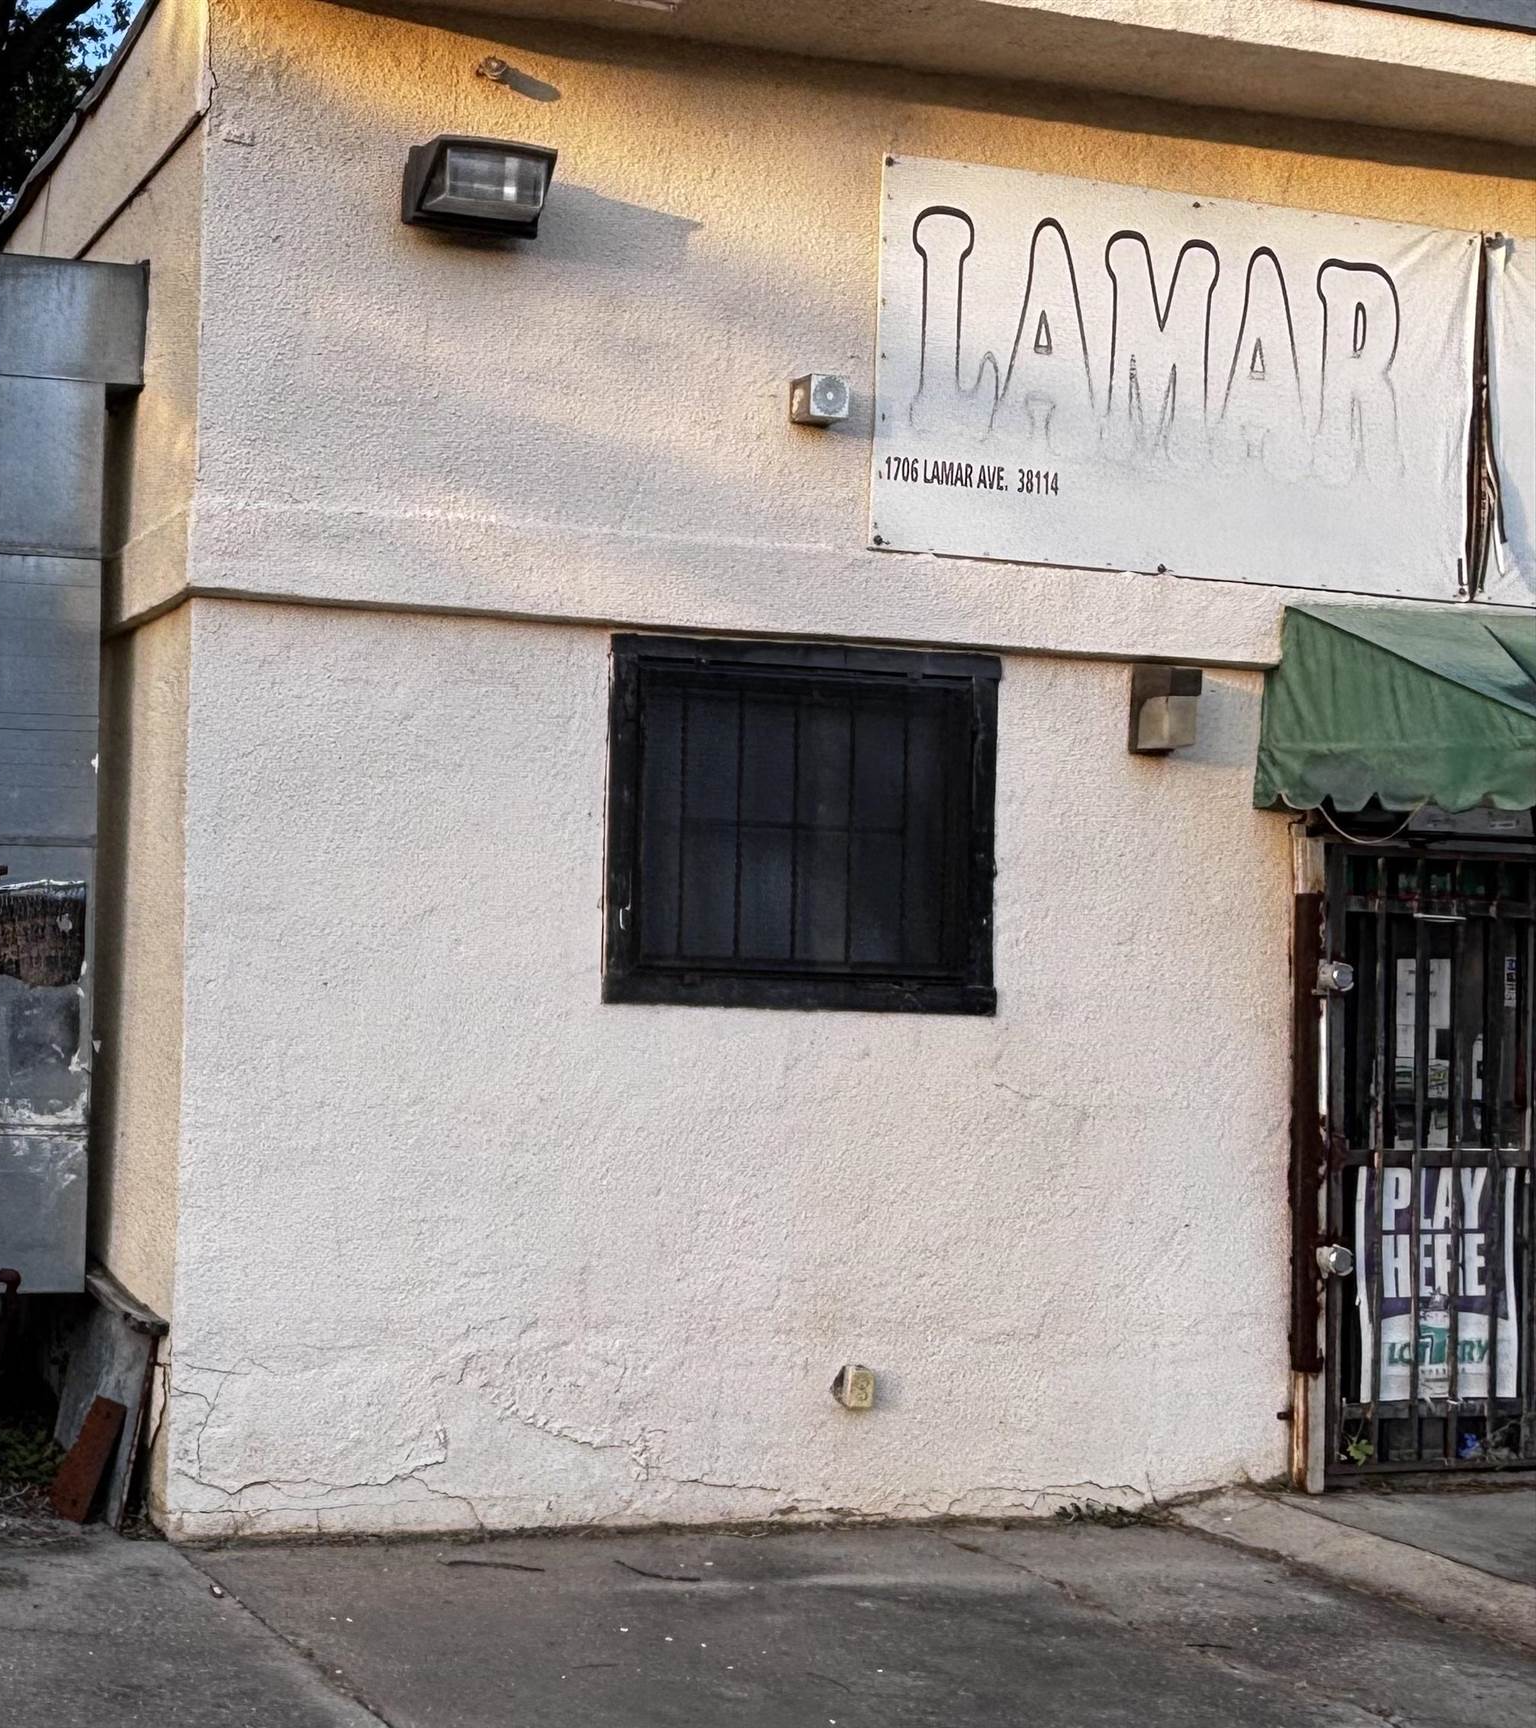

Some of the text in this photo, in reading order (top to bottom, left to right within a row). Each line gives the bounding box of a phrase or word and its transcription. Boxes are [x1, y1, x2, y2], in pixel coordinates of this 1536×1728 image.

[910, 205, 1407, 478] LAMAR
[885, 456, 1059, 496] 1706 LAMAR AVE. 38114
[1382, 1167, 1488, 1230] PLAY
[1381, 1233, 1487, 1298] HERE
